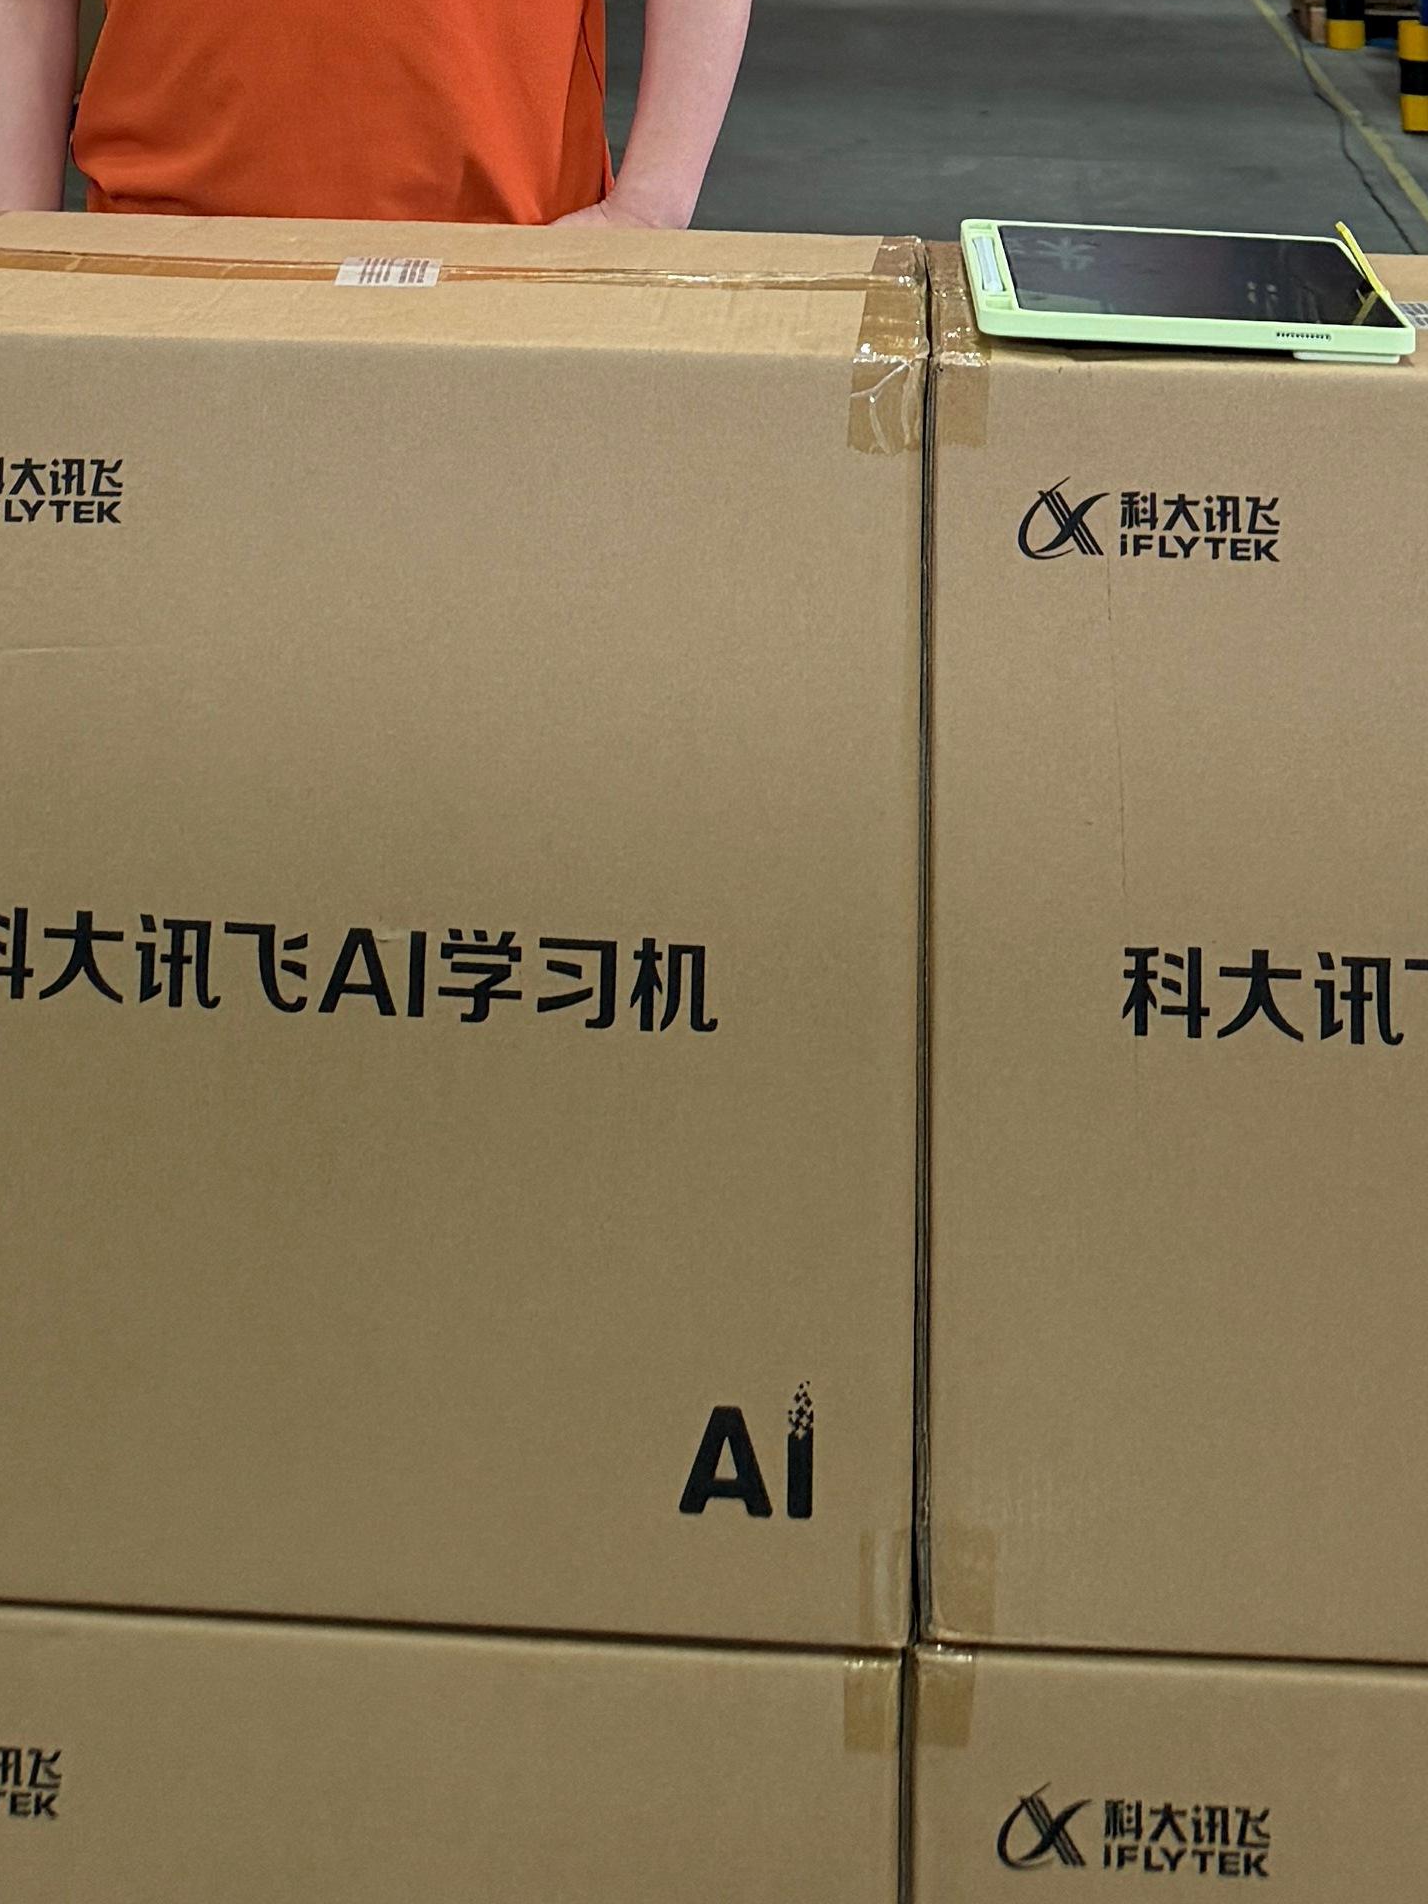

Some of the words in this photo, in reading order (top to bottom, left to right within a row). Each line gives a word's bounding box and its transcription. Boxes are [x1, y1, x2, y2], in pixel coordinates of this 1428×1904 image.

[1119, 490, 1281, 535] 科大讯飞
[1119, 534, 1281, 564] iFLYTEK
[1103, 1797, 1271, 1844] 科大讯飞
